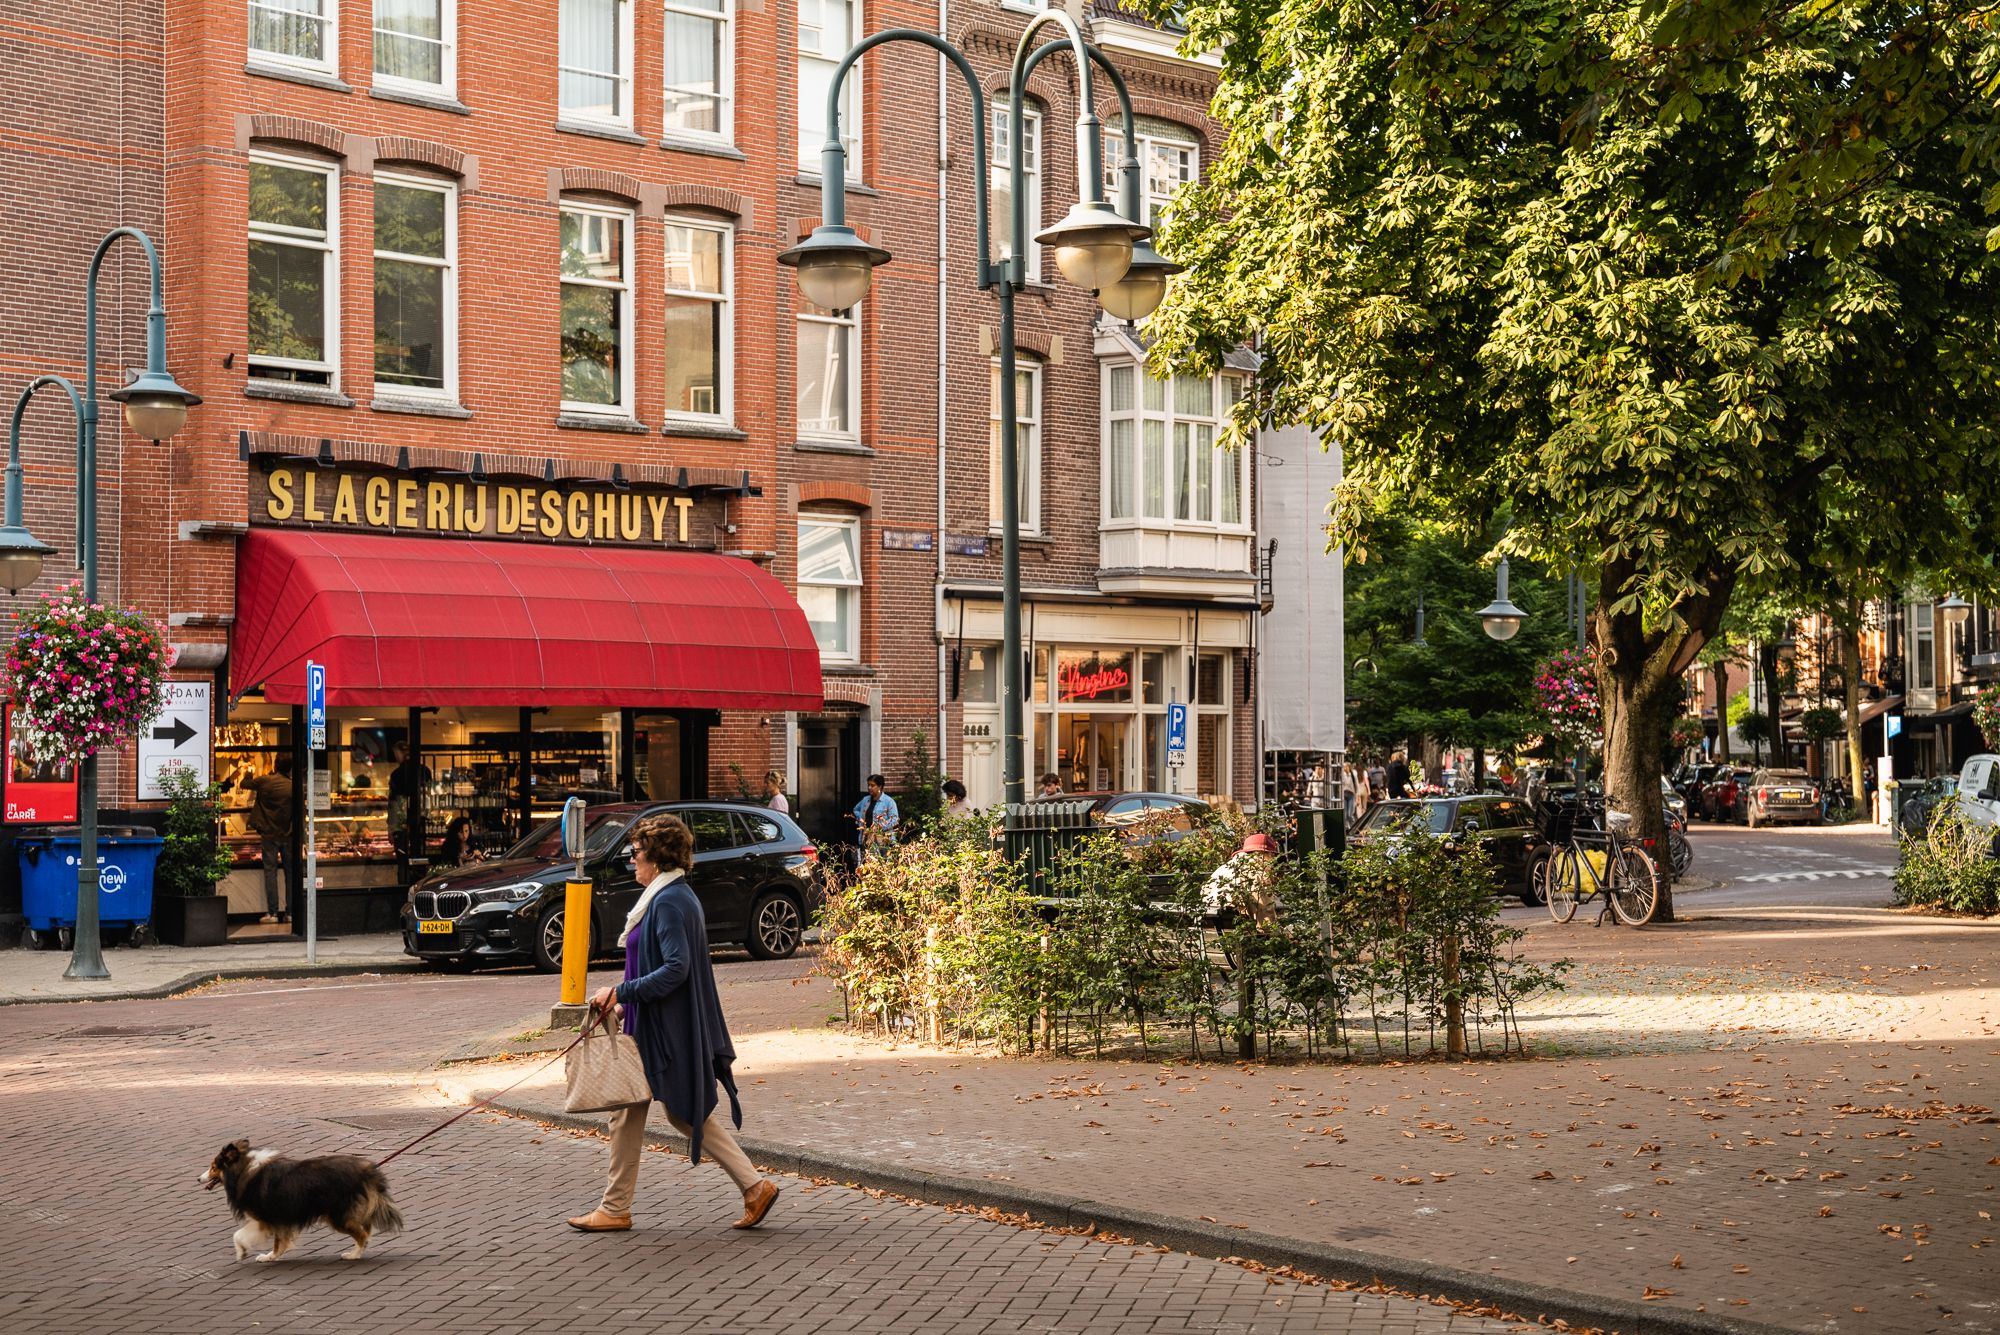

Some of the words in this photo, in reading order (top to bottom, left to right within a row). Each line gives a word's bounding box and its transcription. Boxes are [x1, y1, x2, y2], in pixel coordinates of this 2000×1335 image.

[267, 469, 486, 533] SLAGERIJ
[313, 670, 322, 701] P
[1173, 708, 1183, 731] P
[168, 759, 182, 767] 150
[8, 803, 17, 811] IN
[99, 872, 127, 884] newi
